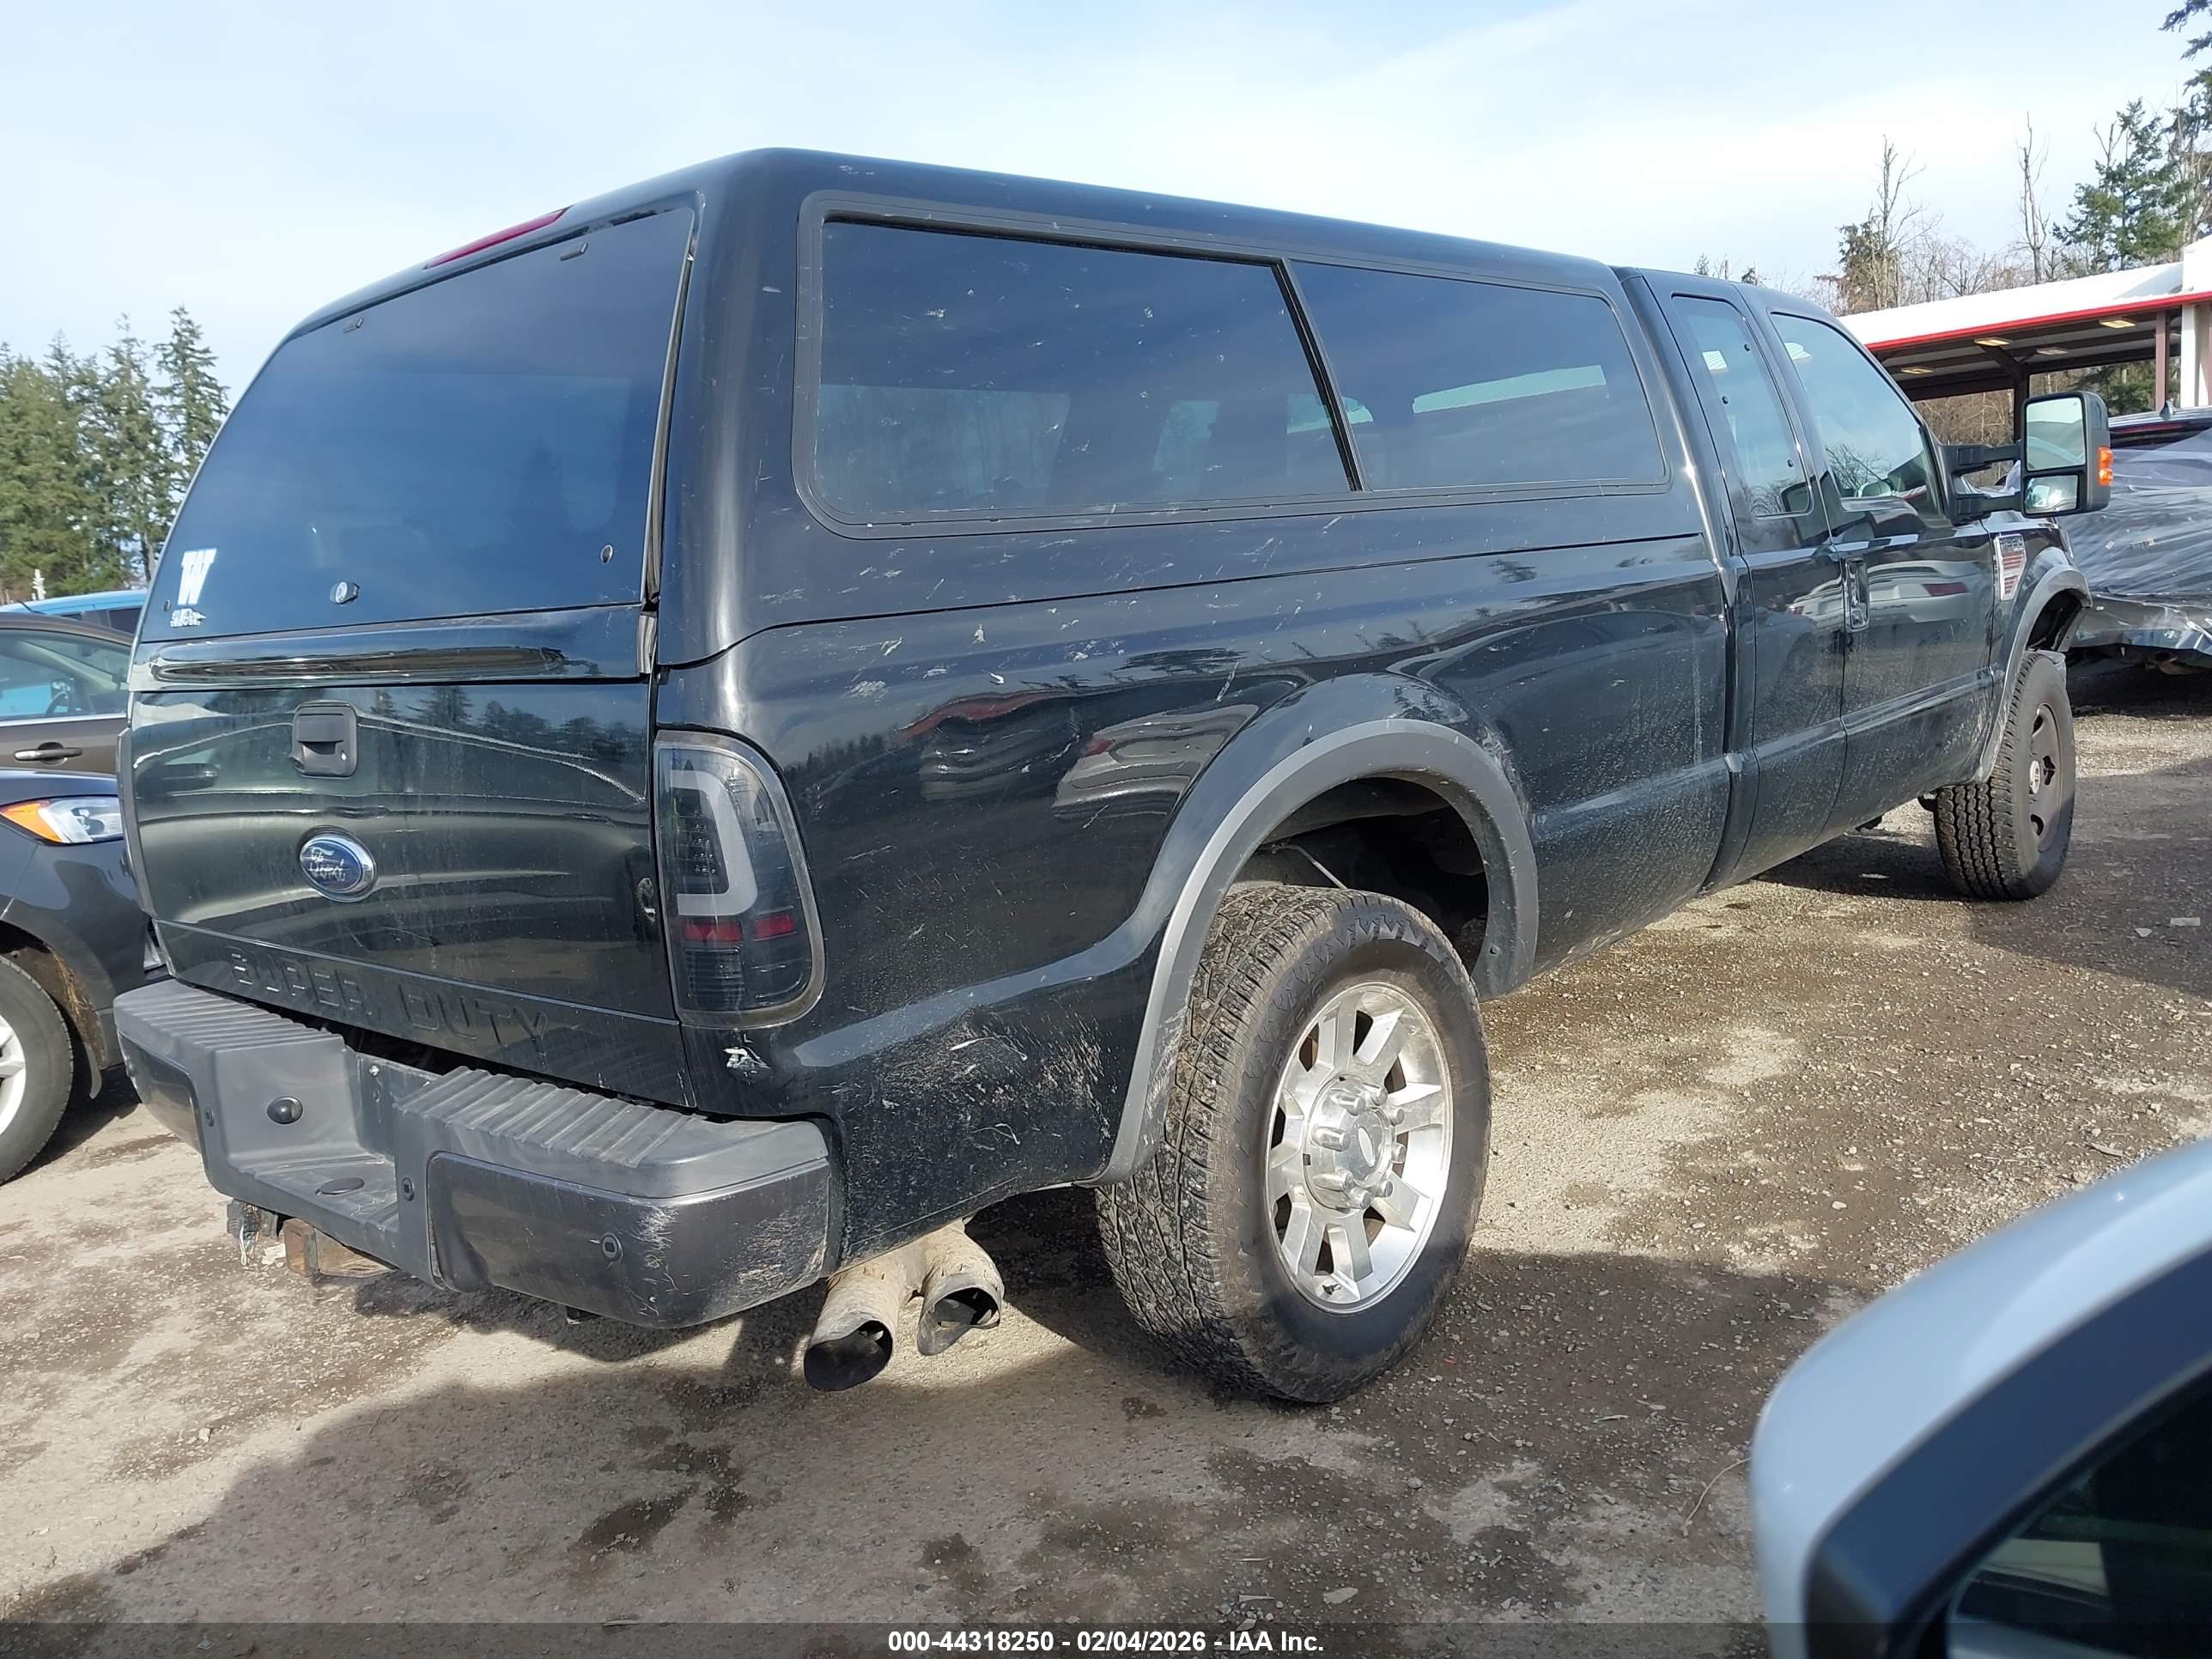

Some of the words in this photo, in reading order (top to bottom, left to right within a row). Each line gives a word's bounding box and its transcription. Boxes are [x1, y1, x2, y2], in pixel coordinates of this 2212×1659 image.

[308, 846, 346, 882] Ford
[227, 946, 375, 1016] SUPER
[398, 983, 550, 1072] DUTY
